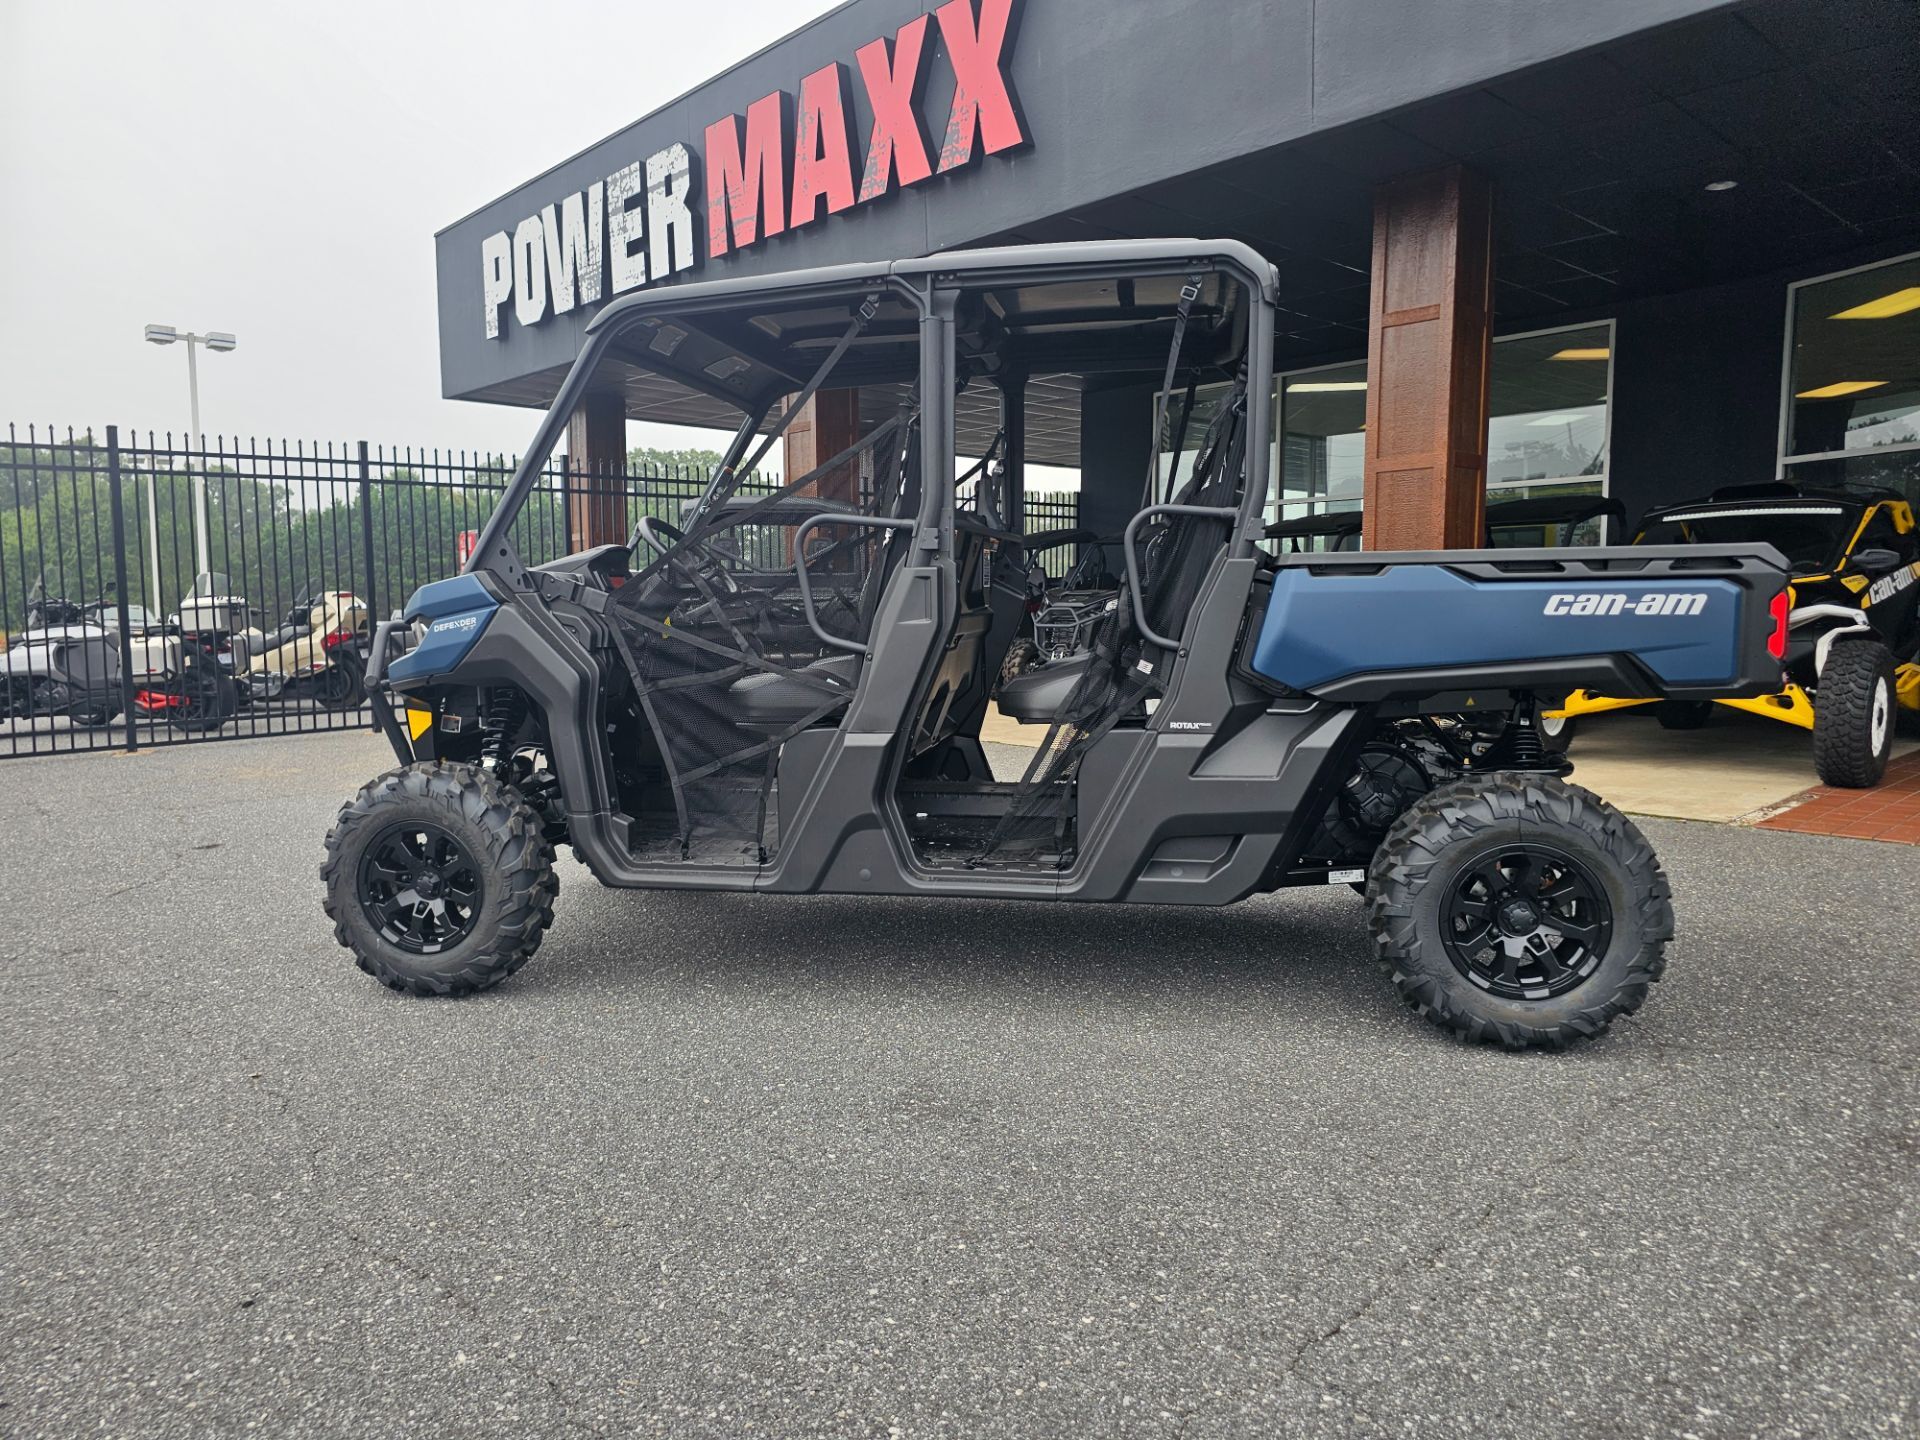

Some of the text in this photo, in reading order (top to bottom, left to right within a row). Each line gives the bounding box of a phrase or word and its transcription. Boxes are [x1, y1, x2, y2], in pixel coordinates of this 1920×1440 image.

[482, 0, 1024, 340] POWER MAXX
[1869, 565, 1914, 605] can-am
[1543, 593, 1708, 616] can-am
[434, 617, 477, 632] DEFENDER
[1169, 721, 1200, 729] ROTAX
